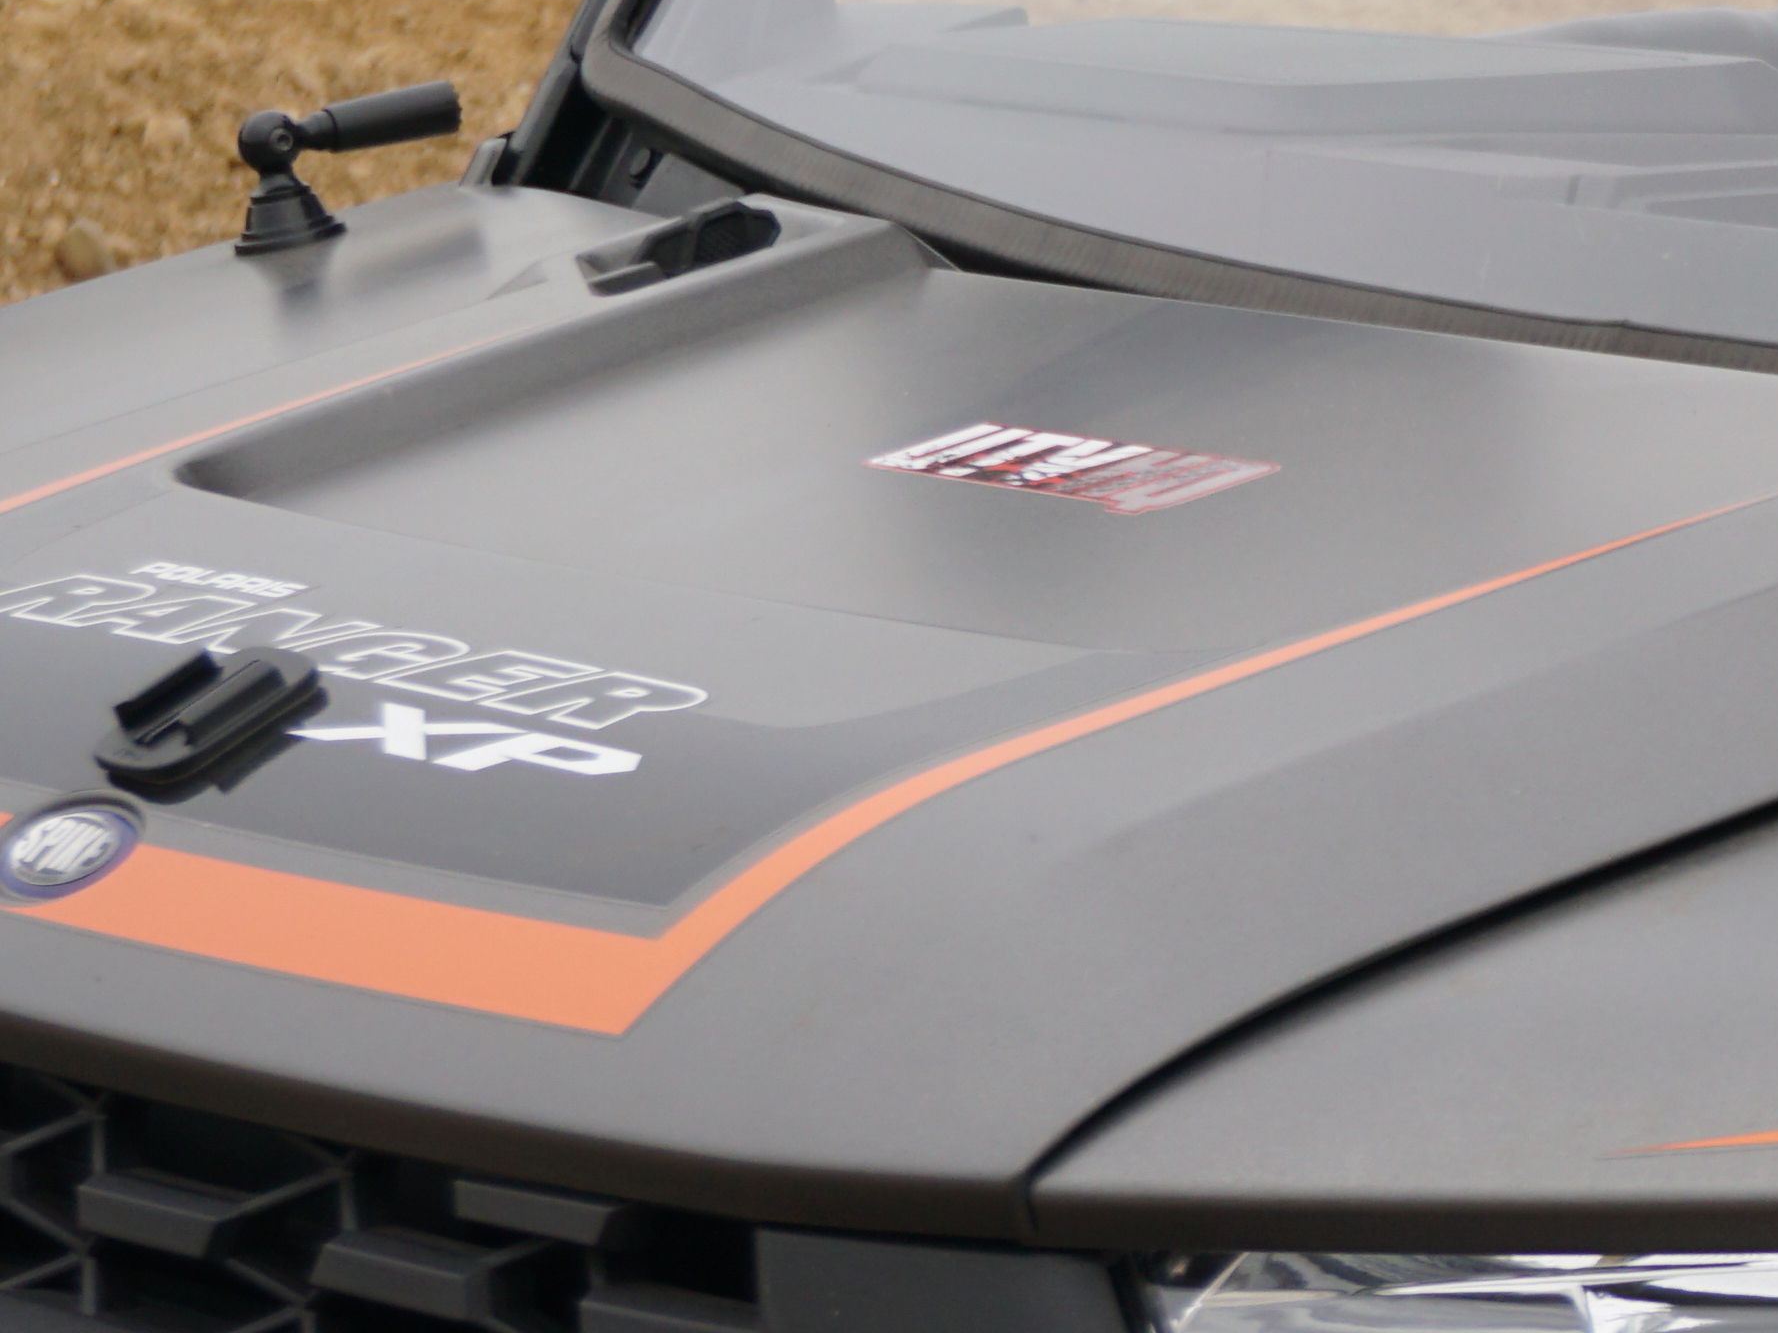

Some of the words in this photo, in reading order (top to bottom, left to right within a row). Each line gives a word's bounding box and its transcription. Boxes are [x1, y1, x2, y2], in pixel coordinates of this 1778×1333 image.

[128, 561, 310, 598] POLARIS
[0, 574, 709, 730] RANGER
[283, 701, 643, 775] XP
[8, 815, 117, 871] SPIKE
